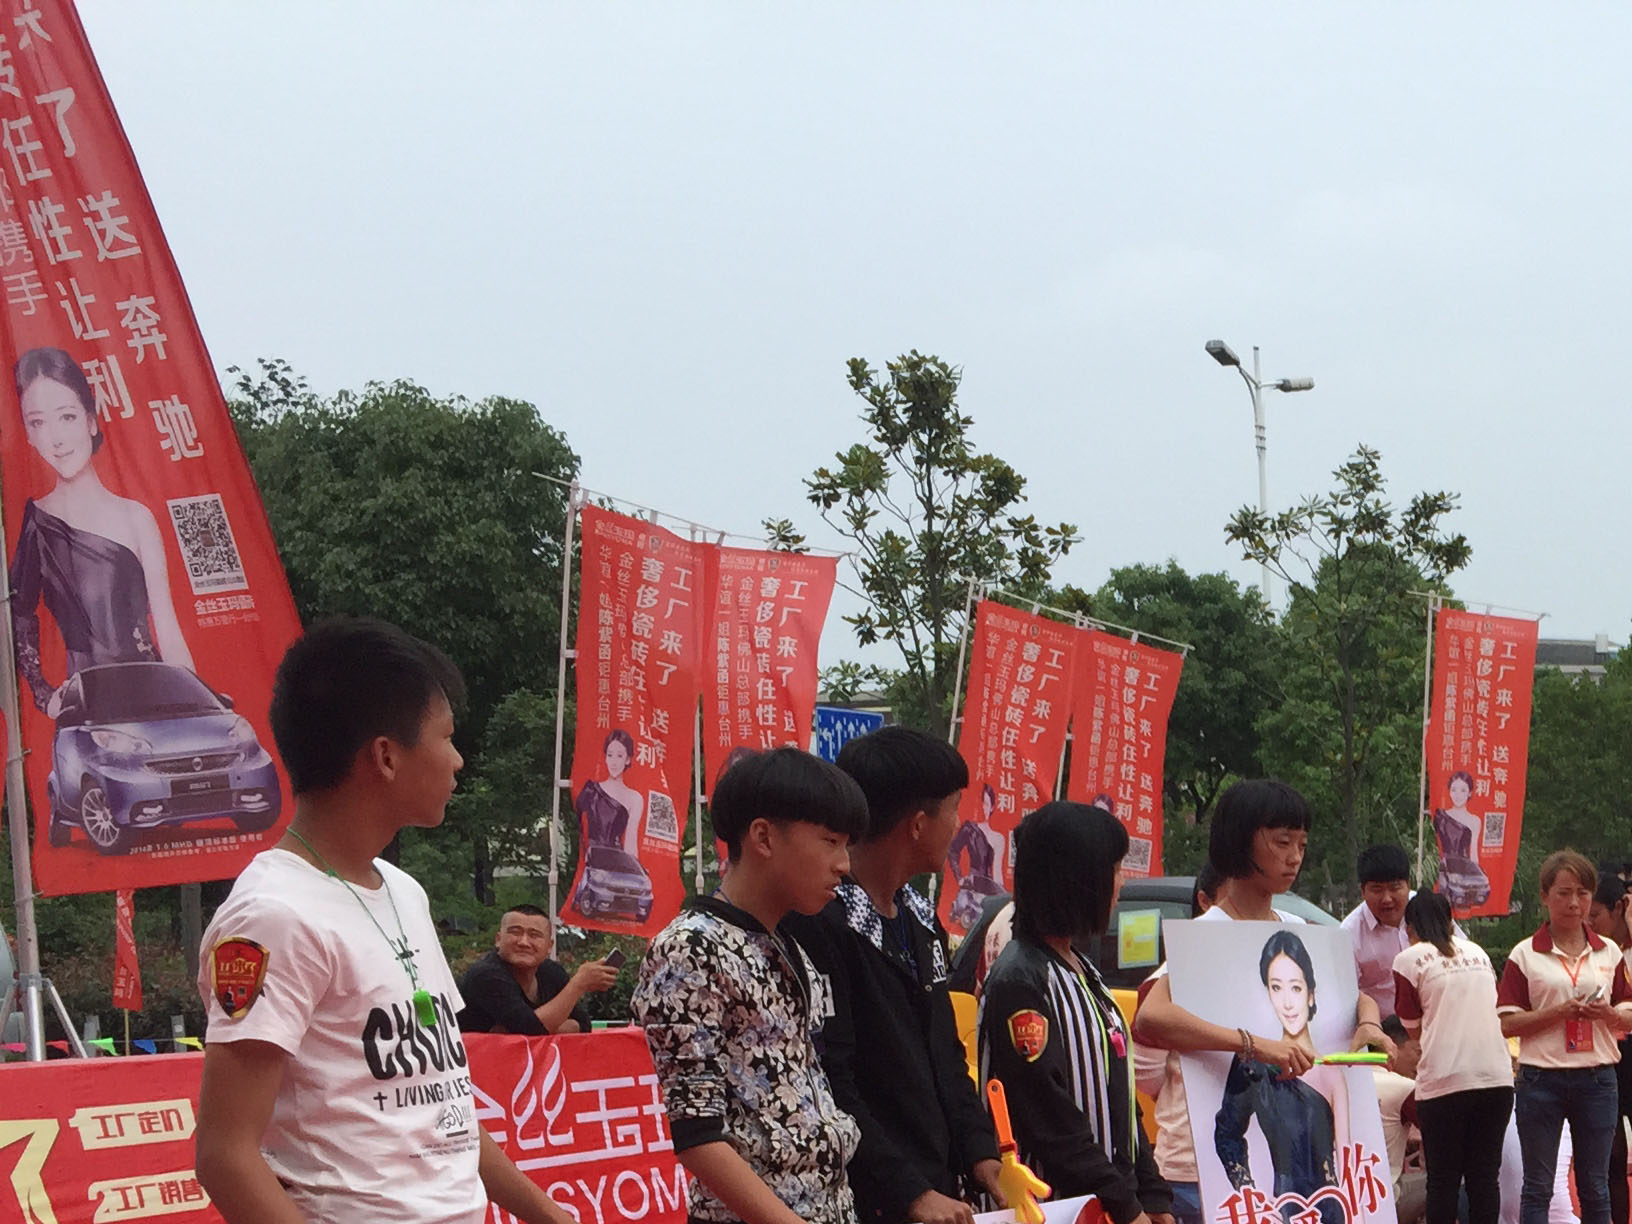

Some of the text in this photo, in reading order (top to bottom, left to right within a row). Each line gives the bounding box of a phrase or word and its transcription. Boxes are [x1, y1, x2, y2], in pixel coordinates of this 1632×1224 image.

[656, 566, 692, 685] 工厂来了
[776, 580, 808, 687] 工厂来了
[1029, 648, 1064, 744] 工厂来了
[1140, 672, 1160, 757] 工厂来了
[1495, 641, 1517, 729] 工厂来了
